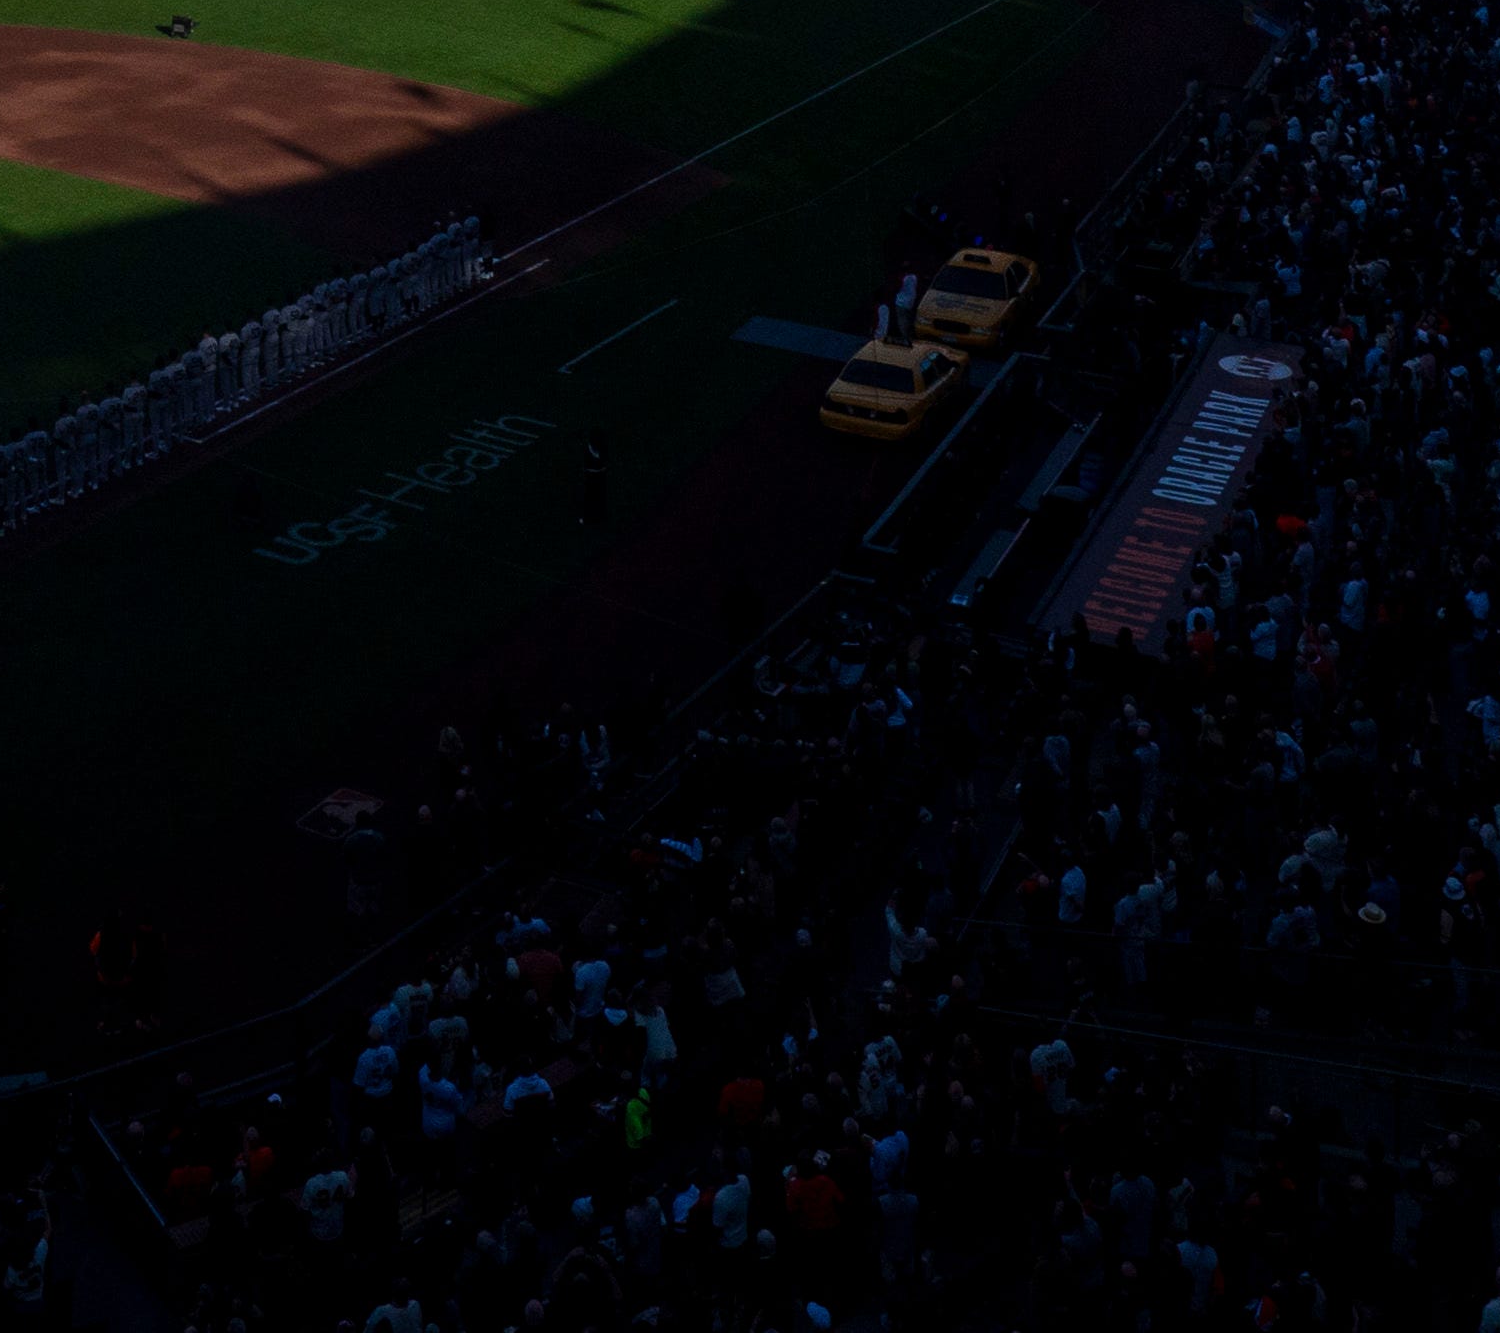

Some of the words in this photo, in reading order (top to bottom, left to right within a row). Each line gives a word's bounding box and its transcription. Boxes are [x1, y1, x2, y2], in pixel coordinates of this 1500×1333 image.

[1192, 389, 1271, 437] PARK
[252, 501, 398, 566] UCSF
[358, 414, 558, 511] Health
[1152, 435, 1247, 506] ORACLE
[1083, 535, 1193, 640] WELCOME
